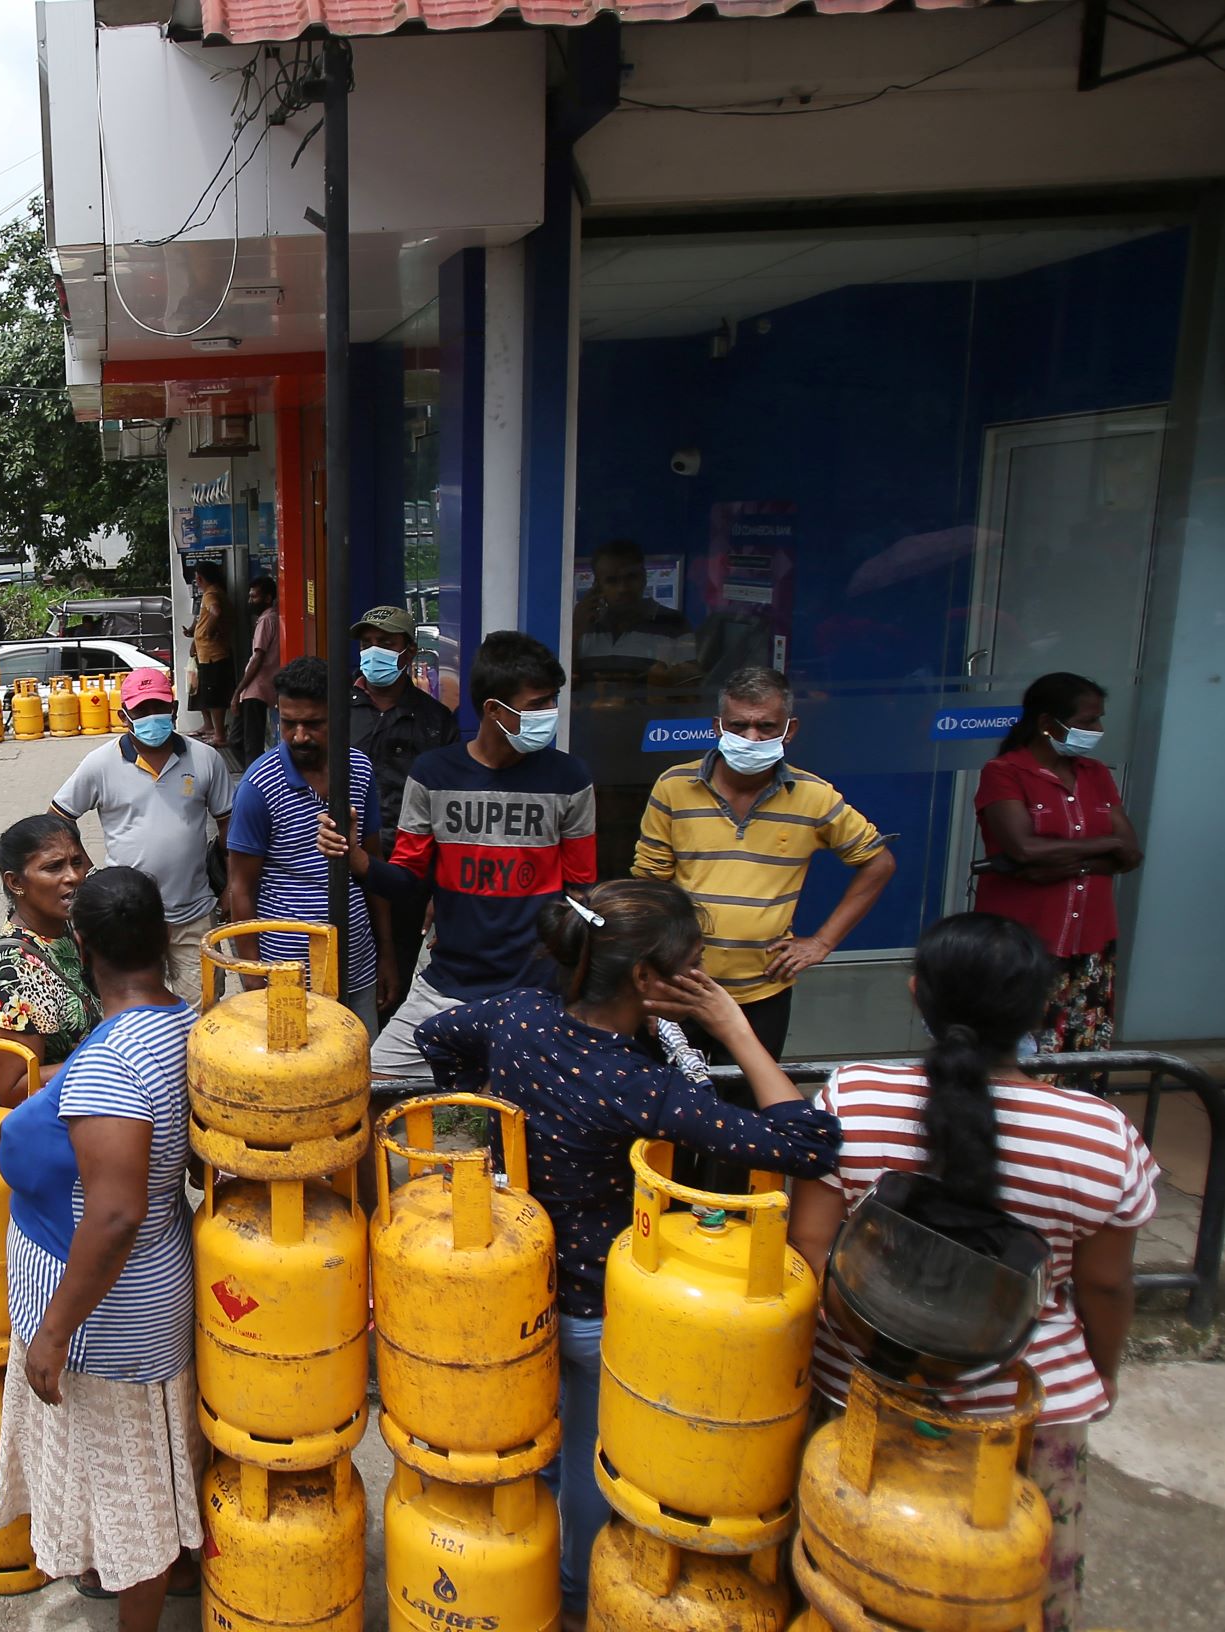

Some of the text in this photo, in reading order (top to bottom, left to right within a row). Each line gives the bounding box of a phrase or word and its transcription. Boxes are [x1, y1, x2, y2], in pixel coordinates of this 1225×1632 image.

[445, 801, 545, 836] SUPER
[635, 1207, 651, 1238] 19
[401, 1585, 500, 1631] LAUGFS
